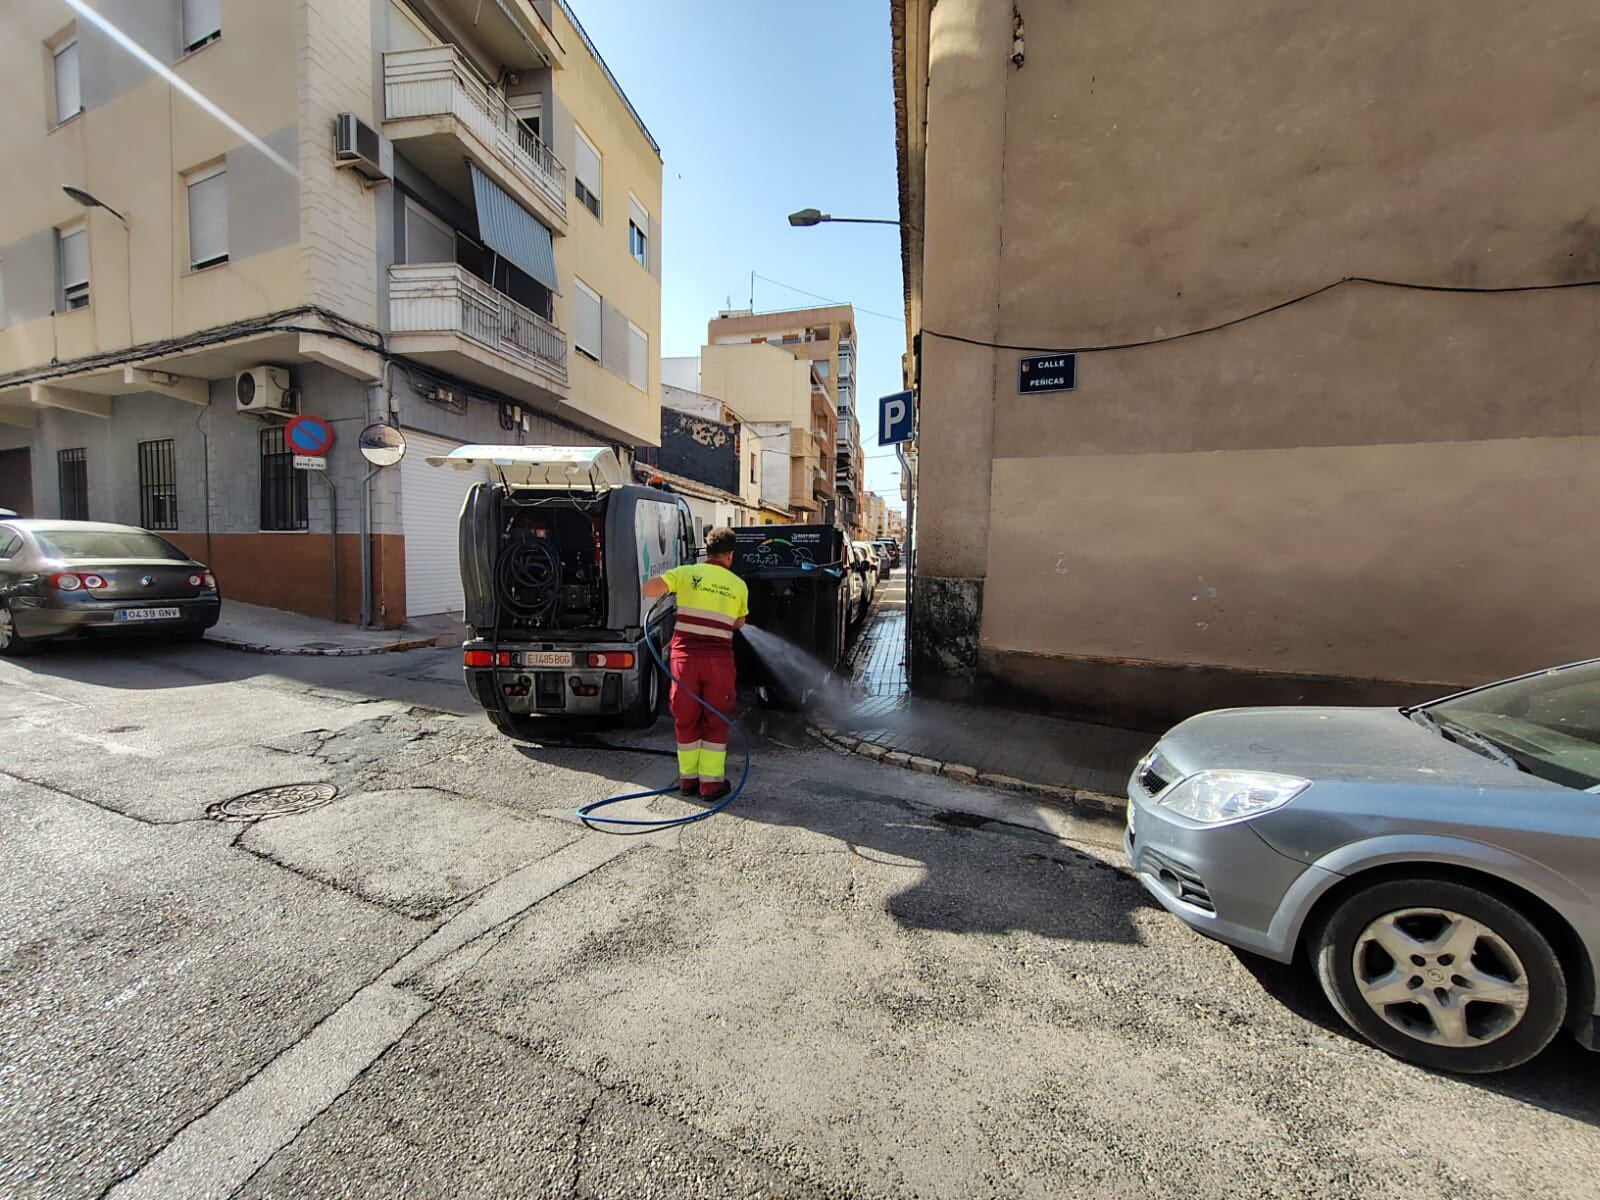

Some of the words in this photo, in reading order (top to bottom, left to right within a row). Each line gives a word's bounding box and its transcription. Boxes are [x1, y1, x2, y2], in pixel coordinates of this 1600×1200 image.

[1038, 360, 1065, 369] CALLE
[1030, 376, 1065, 387] PEÑICAS
[884, 400, 906, 440] P
[128, 610, 156, 619] 0439
[158, 609, 177, 617] GNV
